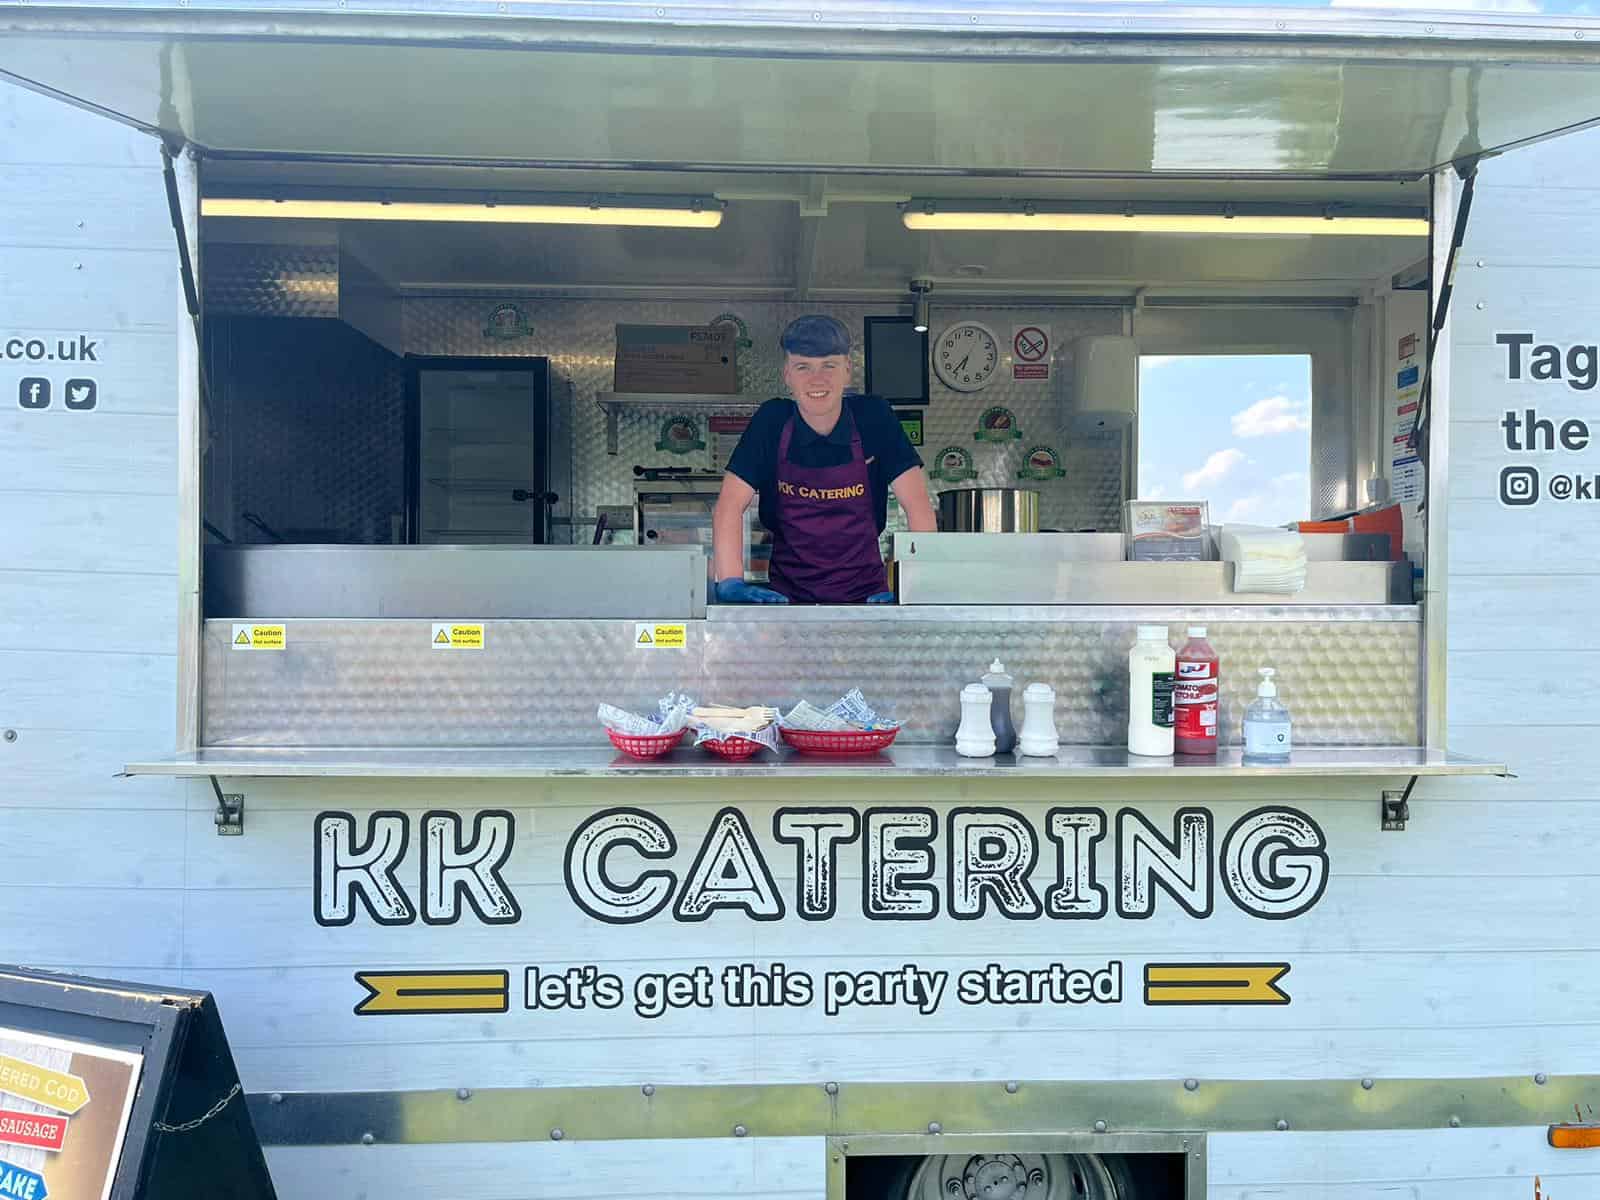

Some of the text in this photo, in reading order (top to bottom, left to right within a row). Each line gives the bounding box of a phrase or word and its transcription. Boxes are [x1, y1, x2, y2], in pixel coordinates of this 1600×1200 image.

[1496, 333, 1598, 390] Tag
[1501, 409, 1589, 451] the
[798, 484, 864, 500] CATERING
[254, 629, 282, 637] Caution
[452, 628, 481, 636] Caution
[314, 805, 1330, 927] KK CATERING
[634, 968, 713, 1018] get
[721, 963, 812, 1008] this
[825, 963, 948, 1016] party
[958, 961, 1123, 1005] started
[45, 1080, 80, 1102] COD
[0, 1117, 59, 1139] SAUSAGE
